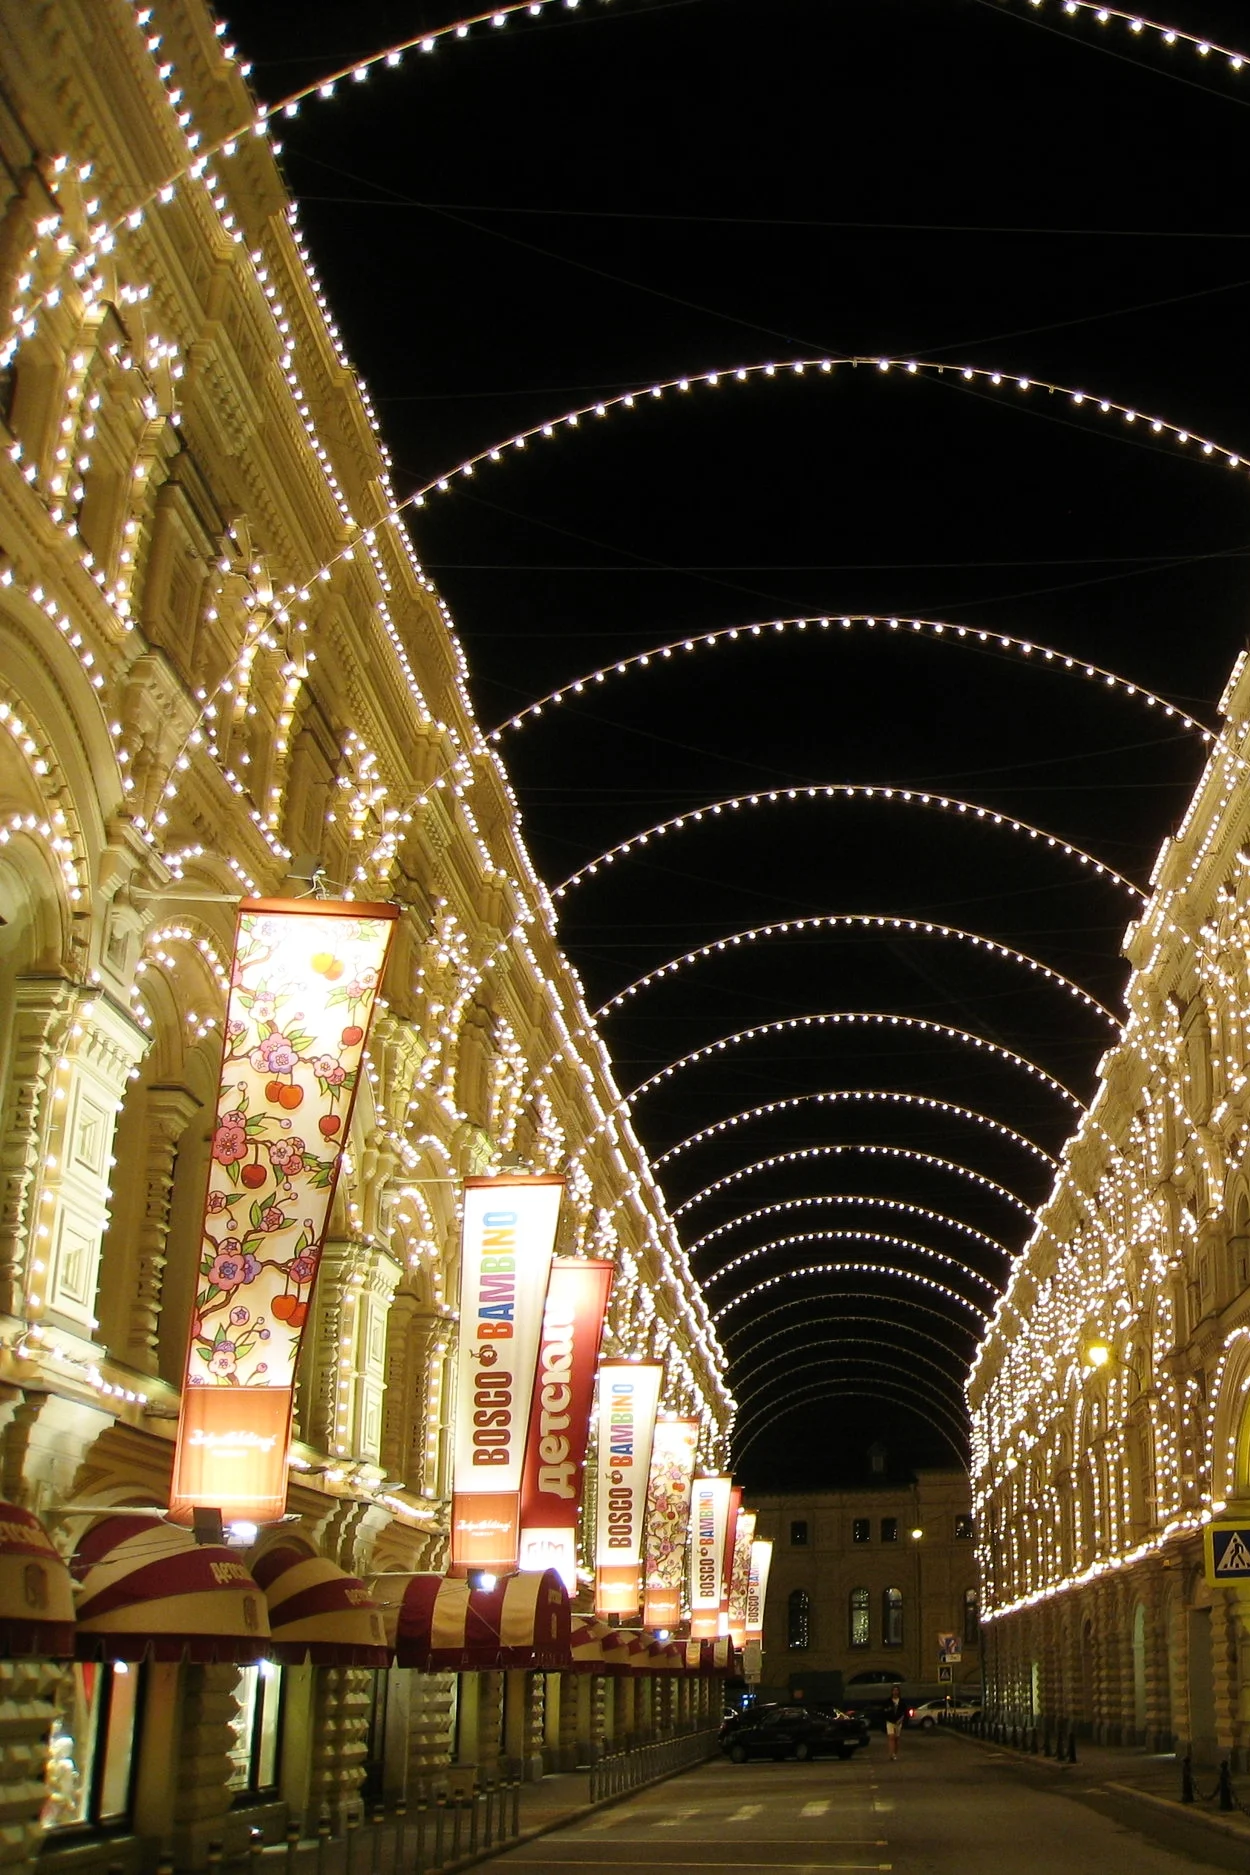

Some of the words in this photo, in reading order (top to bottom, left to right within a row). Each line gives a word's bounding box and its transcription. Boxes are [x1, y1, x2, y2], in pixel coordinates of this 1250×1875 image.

[477, 1211, 517, 1340] BAMBINO
[473, 1371, 513, 1466] BOSCO
[609, 1383, 634, 1467] BAMBINO
[608, 1487, 633, 1548] BOSCO
[700, 1491, 714, 1546] BAMBINO
[700, 1558, 714, 1597] BOSCO
[748, 1595, 760, 1624] BOSCO
